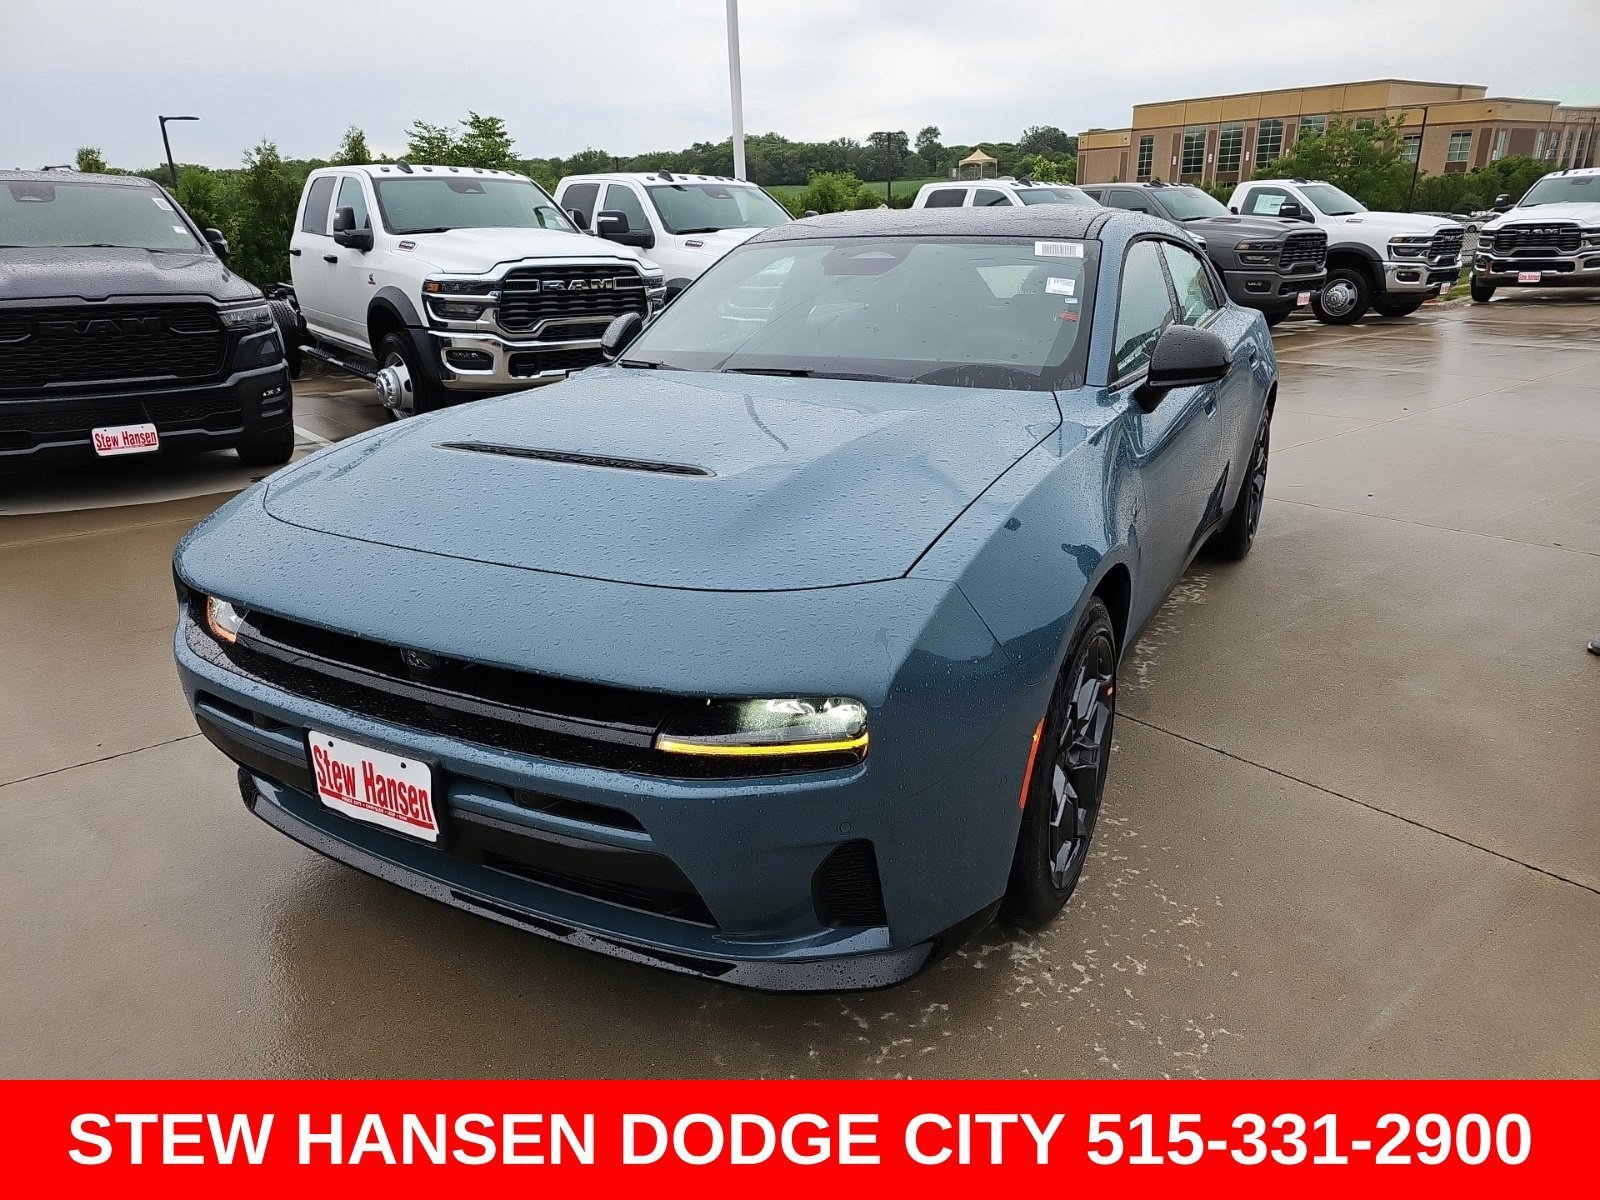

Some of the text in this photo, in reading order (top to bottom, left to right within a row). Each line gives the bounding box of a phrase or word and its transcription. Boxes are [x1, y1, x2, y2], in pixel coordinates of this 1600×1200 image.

[542, 278, 613, 291] RAM
[38, 317, 162, 336] RAM
[94, 430, 157, 448] Stew Hansen
[313, 744, 433, 823] Stew Hansen
